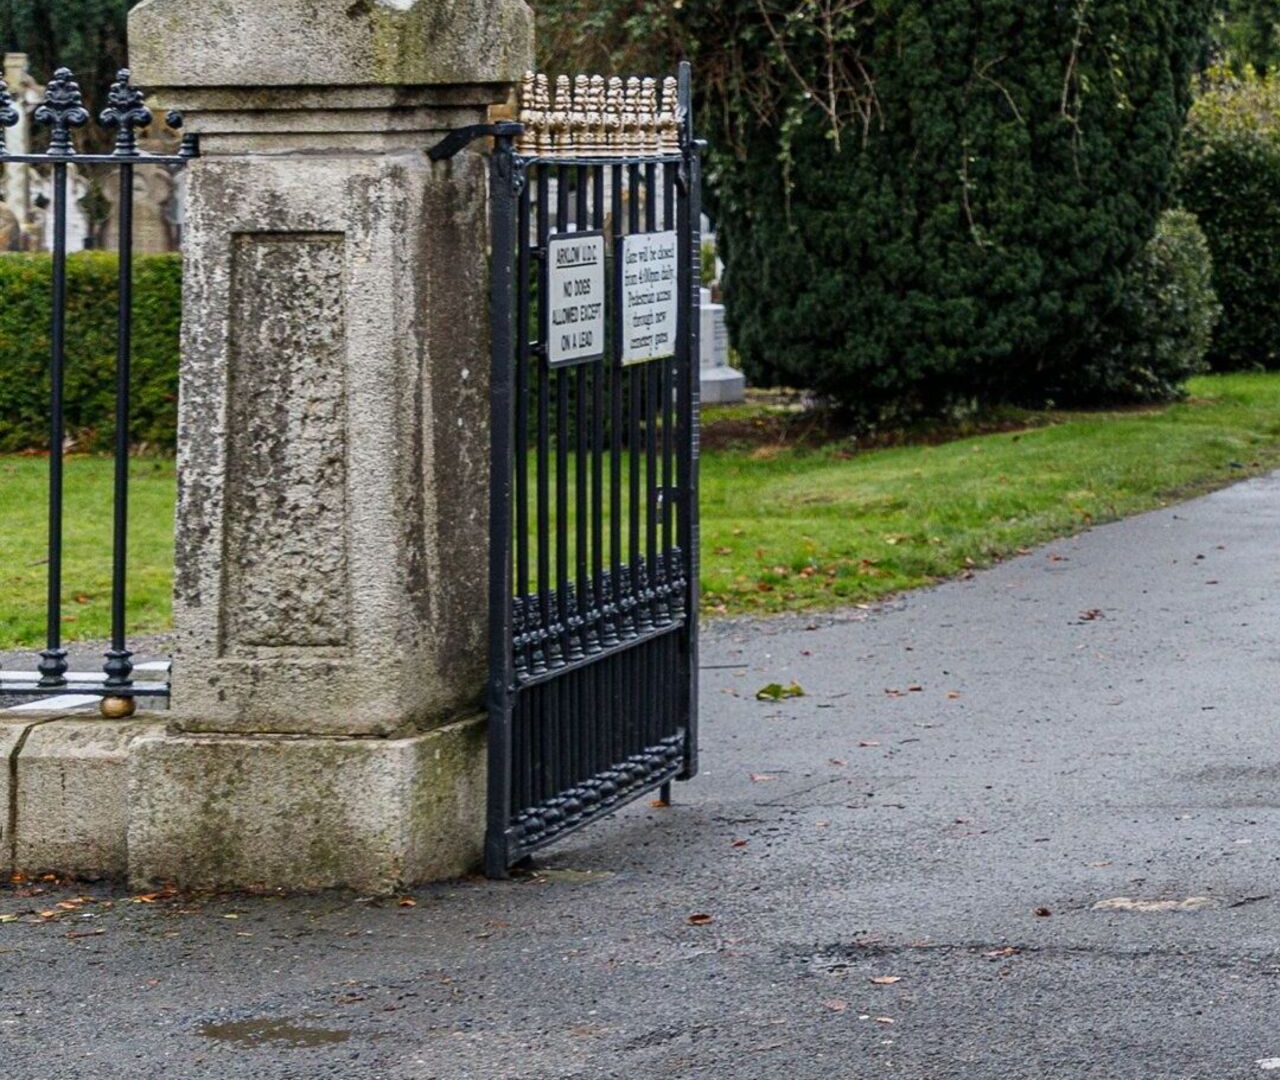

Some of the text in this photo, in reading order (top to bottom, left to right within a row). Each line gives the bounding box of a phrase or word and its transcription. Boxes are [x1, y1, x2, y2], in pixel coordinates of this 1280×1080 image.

[556, 246, 580, 264] ARKLOW
[649, 244, 656, 261] be
[657, 241, 674, 259] closed
[563, 278, 591, 298] NO DOGS
[624, 270, 638, 286] from
[628, 289, 671, 308] Pedestrian access
[552, 302, 602, 326] ALLOWED EXCEPT
[632, 310, 666, 330] through new
[560, 330, 592, 351] ON A LEAD
